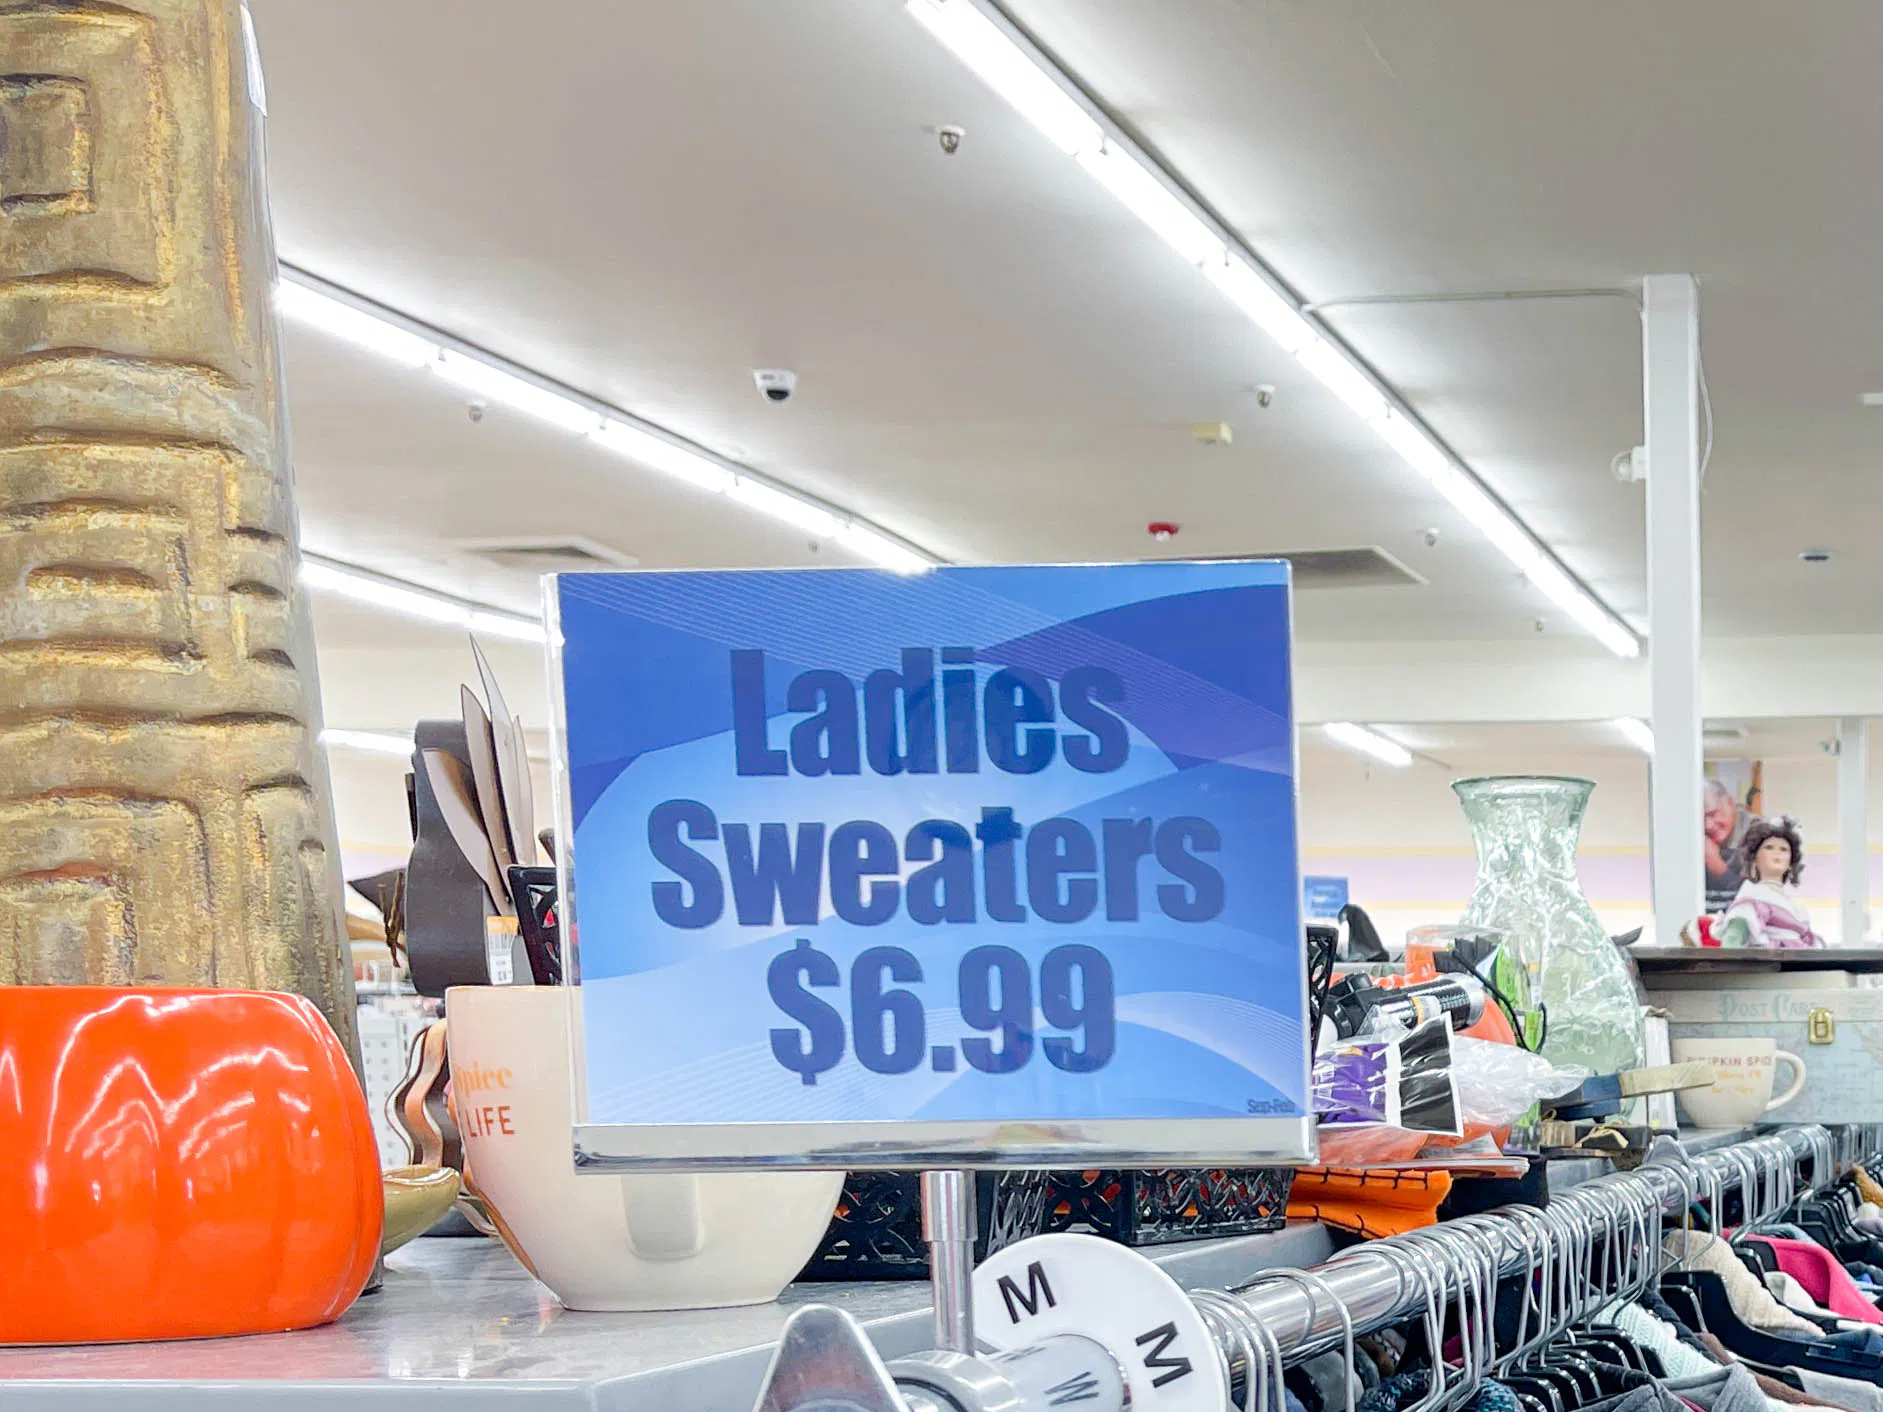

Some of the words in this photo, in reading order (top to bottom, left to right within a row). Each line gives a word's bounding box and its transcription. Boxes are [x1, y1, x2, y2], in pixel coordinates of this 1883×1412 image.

[730, 646, 1131, 777] Ladies
[648, 800, 1225, 930] Sweaters
[767, 938, 1116, 1086] $6.99
[465, 1105, 516, 1138] LIFE
[996, 1260, 1057, 1325] M
[1135, 1321, 1195, 1389] M
